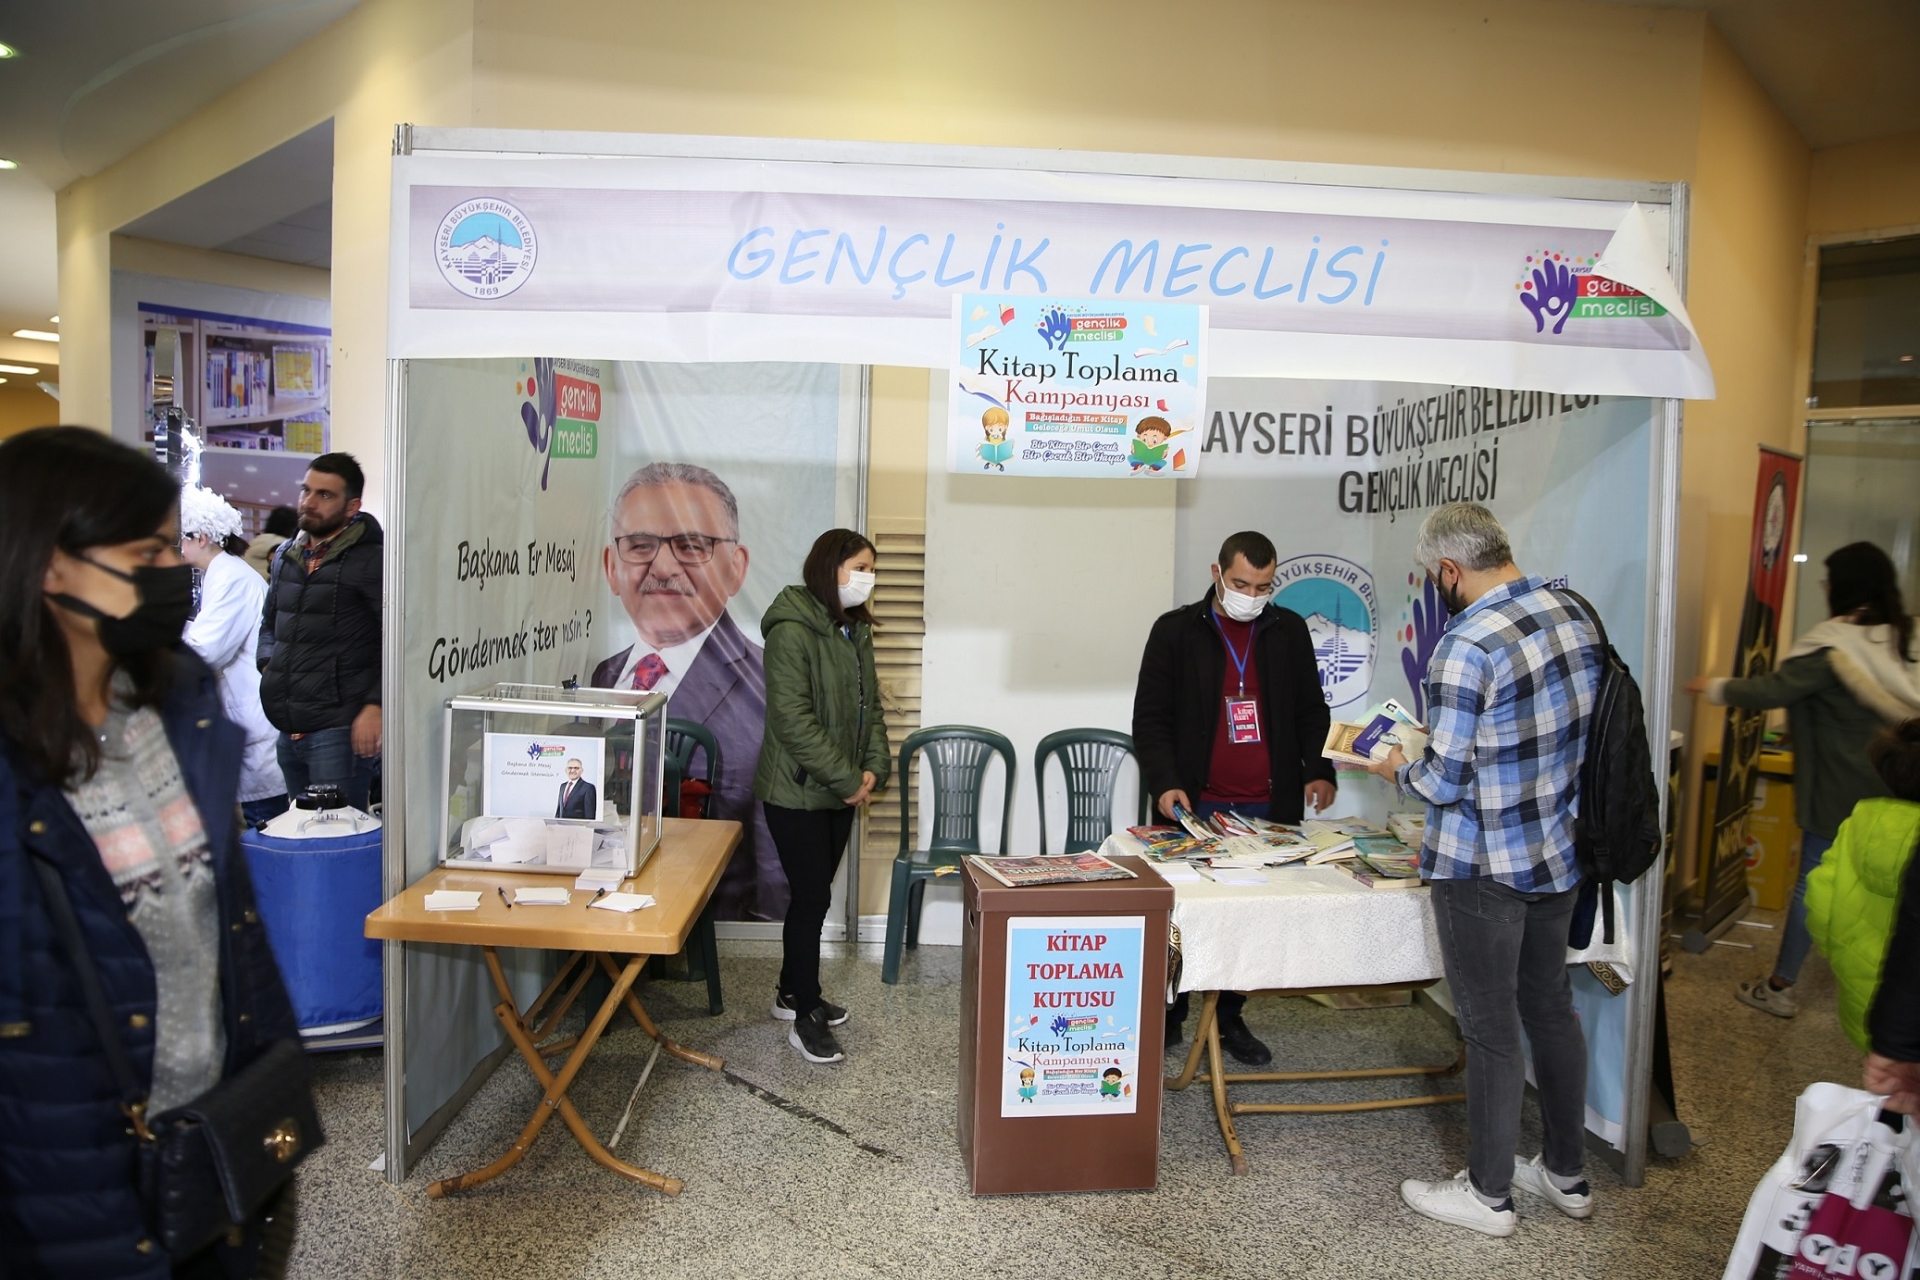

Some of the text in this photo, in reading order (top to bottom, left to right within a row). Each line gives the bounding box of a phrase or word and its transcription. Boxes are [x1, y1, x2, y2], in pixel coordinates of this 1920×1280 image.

[440, 202, 534, 271] KAYSERİ BÜYÜKŞEHİR BELEDİYESİ
[726, 222, 1390, 306] GENÇLİK MECLİSİ
[474, 287, 499, 296] 1869
[1581, 299, 1656, 316] meclisi
[1076, 317, 1121, 331] gençlik
[1073, 330, 1117, 341] meclisi
[978, 348, 1179, 386] Kitap Toplama
[561, 382, 597, 418] gençlik
[1005, 379, 1150, 412] Kampanyası
[1029, 412, 1124, 424] Bağışladığın Her Kitap
[1200, 405, 1333, 456] AYSERİ
[1346, 384, 1467, 459] BÜYÜKŞEHİR
[1033, 423, 1069, 433] Geleceğe
[1071, 425, 1093, 433] Umut
[557, 424, 594, 455] meclisi
[1030, 439, 1048, 450] Bir
[1048, 440, 1074, 452] Kitap
[1074, 441, 1091, 450] Bir
[1022, 449, 1041, 460] Bir
[1074, 451, 1093, 461] Bir
[1094, 451, 1126, 465] Hayat
[1338, 436, 1499, 523] GENÇLİK MECLİSİ
[457, 536, 520, 591] Başkana
[545, 538, 576, 583] Mesaj
[428, 619, 529, 683] Göndermek
[1046, 929, 1107, 952] KİTAP
[1026, 962, 1124, 980] TOPLAMA
[1033, 990, 1116, 1008] KUTUSU
[1018, 1036, 1126, 1055] Kitap Toplama
[1032, 1053, 1110, 1068] Kampanyası
